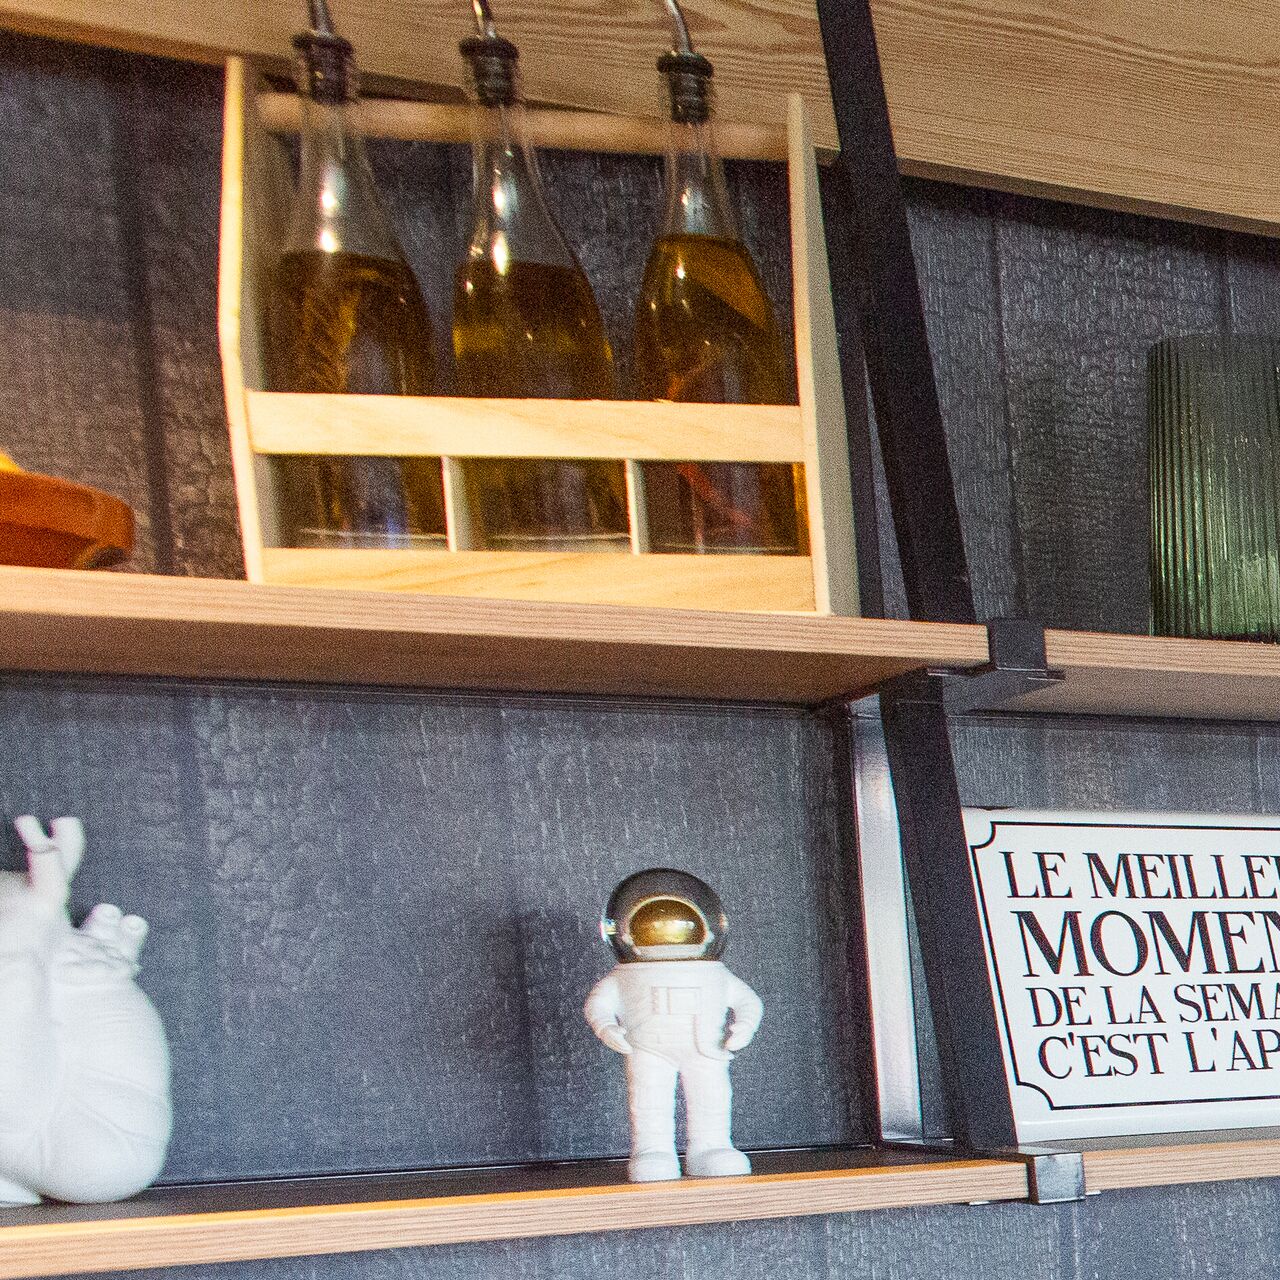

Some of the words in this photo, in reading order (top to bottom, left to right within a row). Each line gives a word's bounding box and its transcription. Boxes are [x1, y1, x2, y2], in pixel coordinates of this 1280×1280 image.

[1000, 851, 1073, 900] LE
[1026, 986, 1093, 1028] DE
[1101, 984, 1167, 1026] LA
[1038, 1032, 1174, 1080] C'EST
